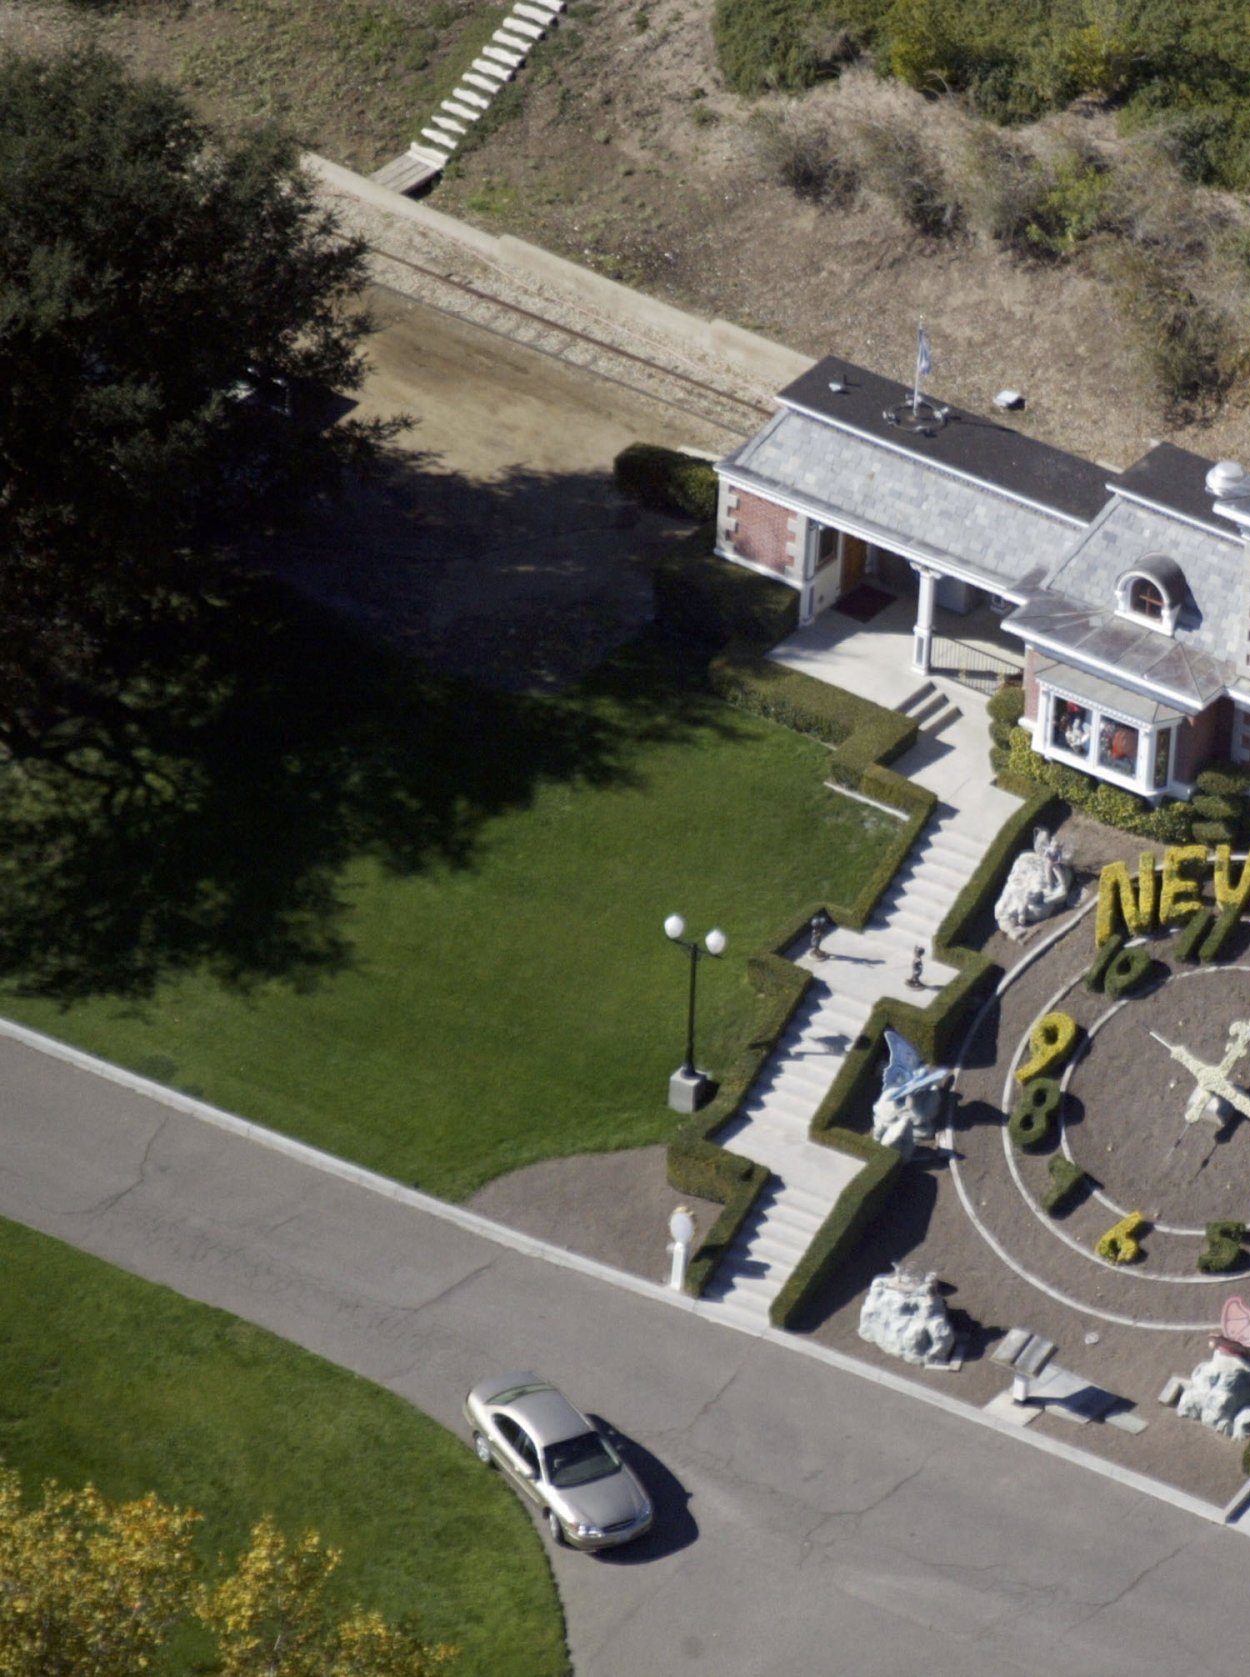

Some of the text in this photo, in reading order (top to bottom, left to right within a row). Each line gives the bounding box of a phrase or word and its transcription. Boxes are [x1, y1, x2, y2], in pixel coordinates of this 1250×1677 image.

[1083, 934, 1150, 999] 10
[1015, 1011, 1077, 1084] 9
[1008, 1077, 1061, 1146] 8
[1043, 1154, 1084, 1212] 7
[1095, 1211, 1143, 1265] 6
[1197, 1221, 1246, 1273] 5
